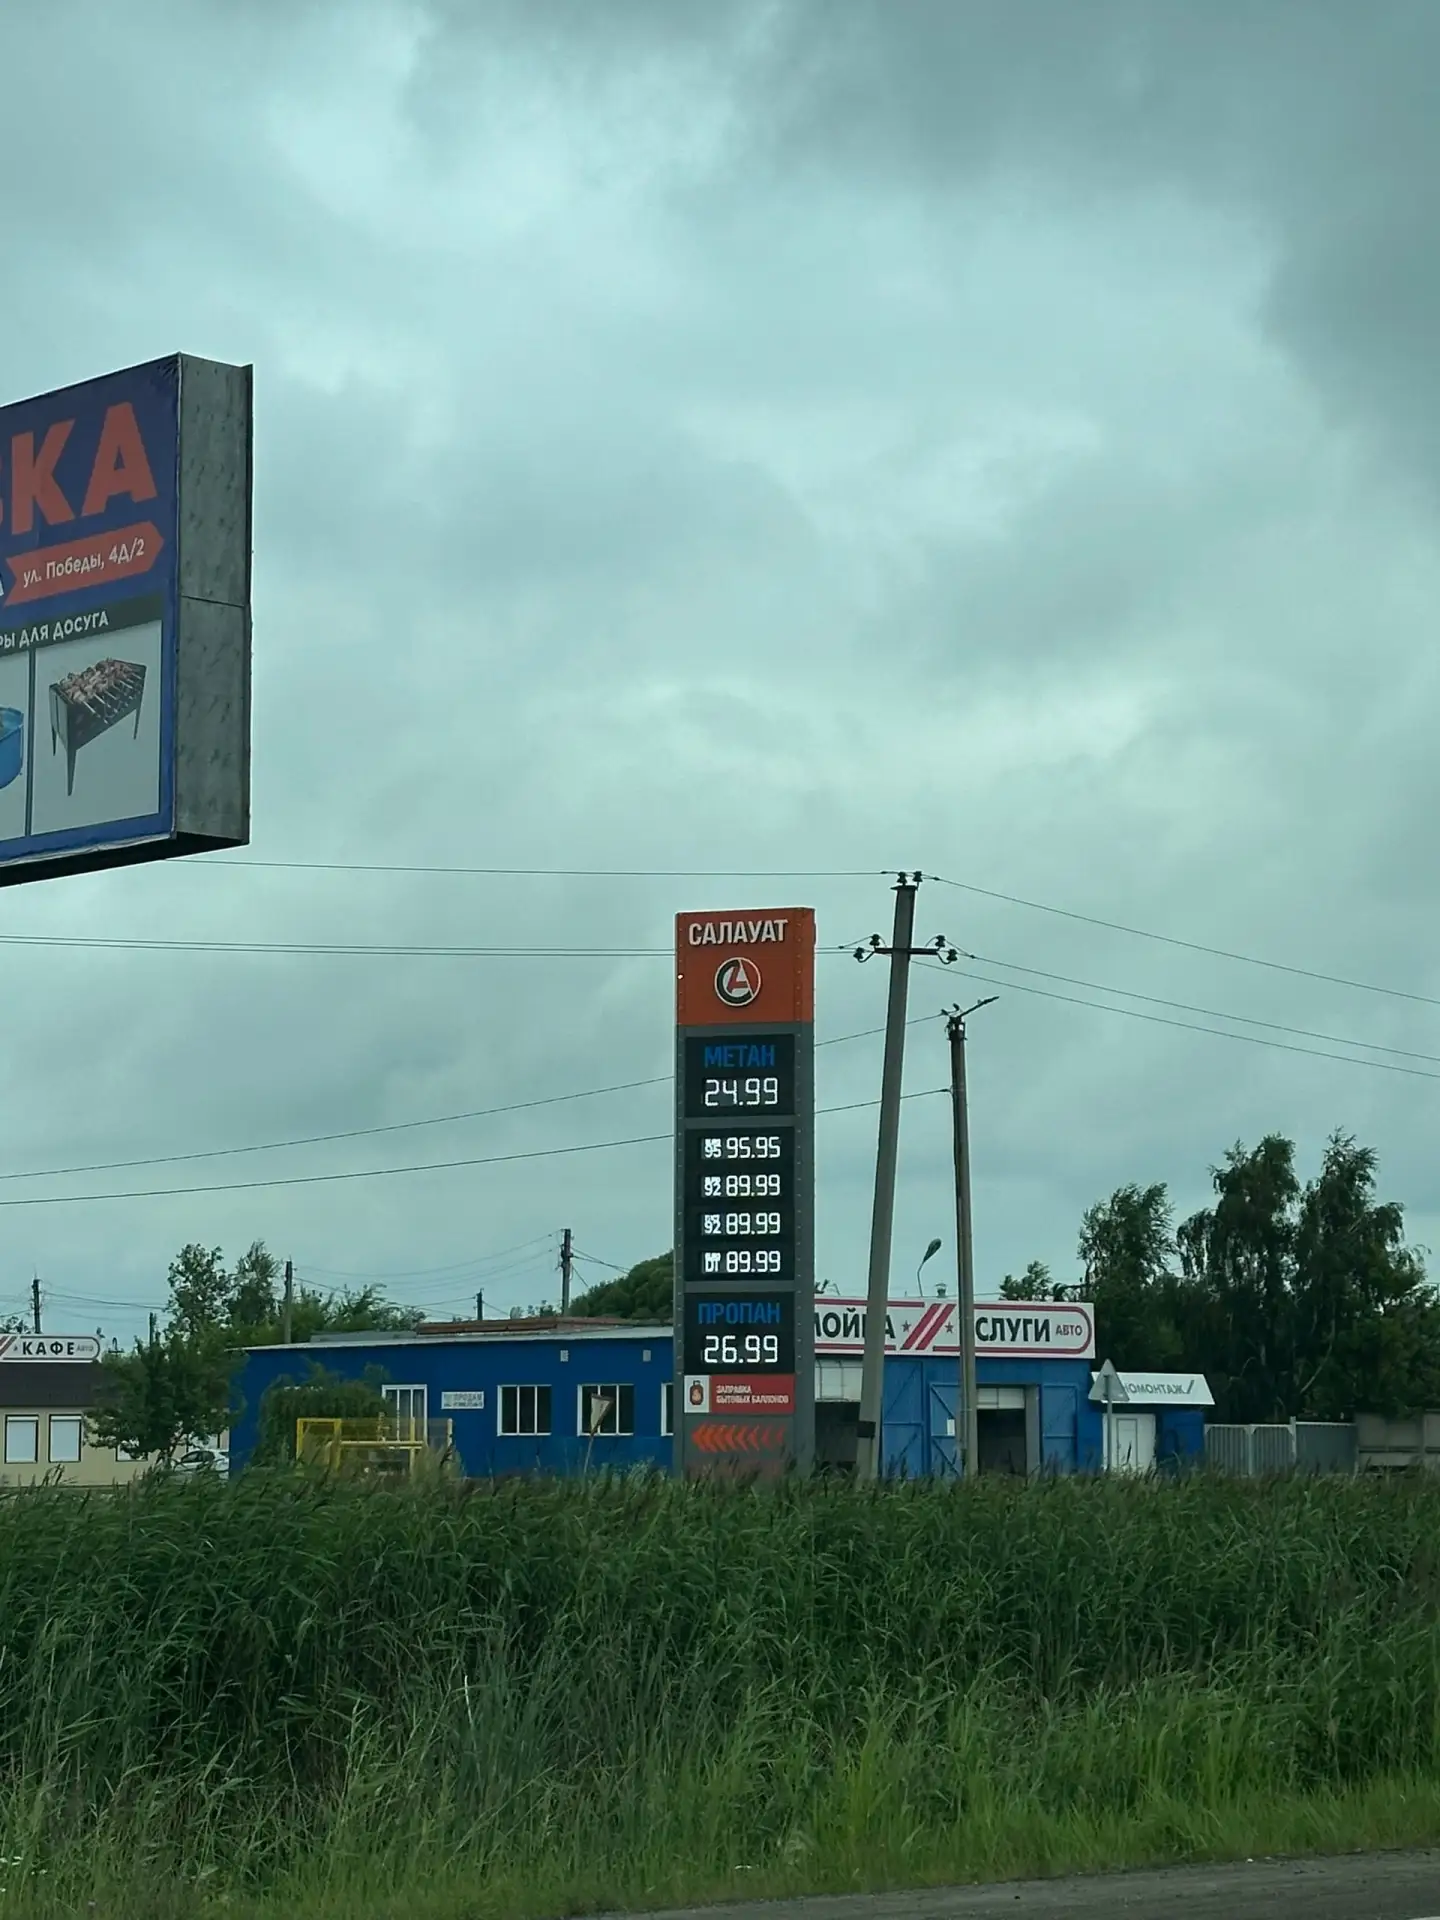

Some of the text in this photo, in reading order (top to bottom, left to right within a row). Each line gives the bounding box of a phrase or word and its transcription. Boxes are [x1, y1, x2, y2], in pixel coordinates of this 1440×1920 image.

[0, 401, 158, 535] КА
[23, 569, 42, 588] ул.
[46, 553, 105, 579] Победы,
[108, 537, 145, 564] 4Д/2
[19, 624, 49, 648] ДЛЯ
[53, 610, 109, 641] ДОСУГА
[688, 919, 788, 946] САЛАУАТ
[704, 1045, 776, 1068] МЕТАН
[704, 1077, 779, 1107] 24.99
[726, 1136, 781, 1159] 95.95
[704, 1174, 781, 1197] 92 89.99
[704, 1212, 781, 1235] 92 89.99
[726, 1250, 781, 1273] 89.99
[698, 1302, 780, 1324] ПРОПАН
[814, 1307, 896, 1339] ОЙА
[975, 1316, 1083, 1342] СЛУГИ АВТО
[22, 1341, 75, 1355] КАФЕ
[704, 1334, 778, 1363] 26.99
